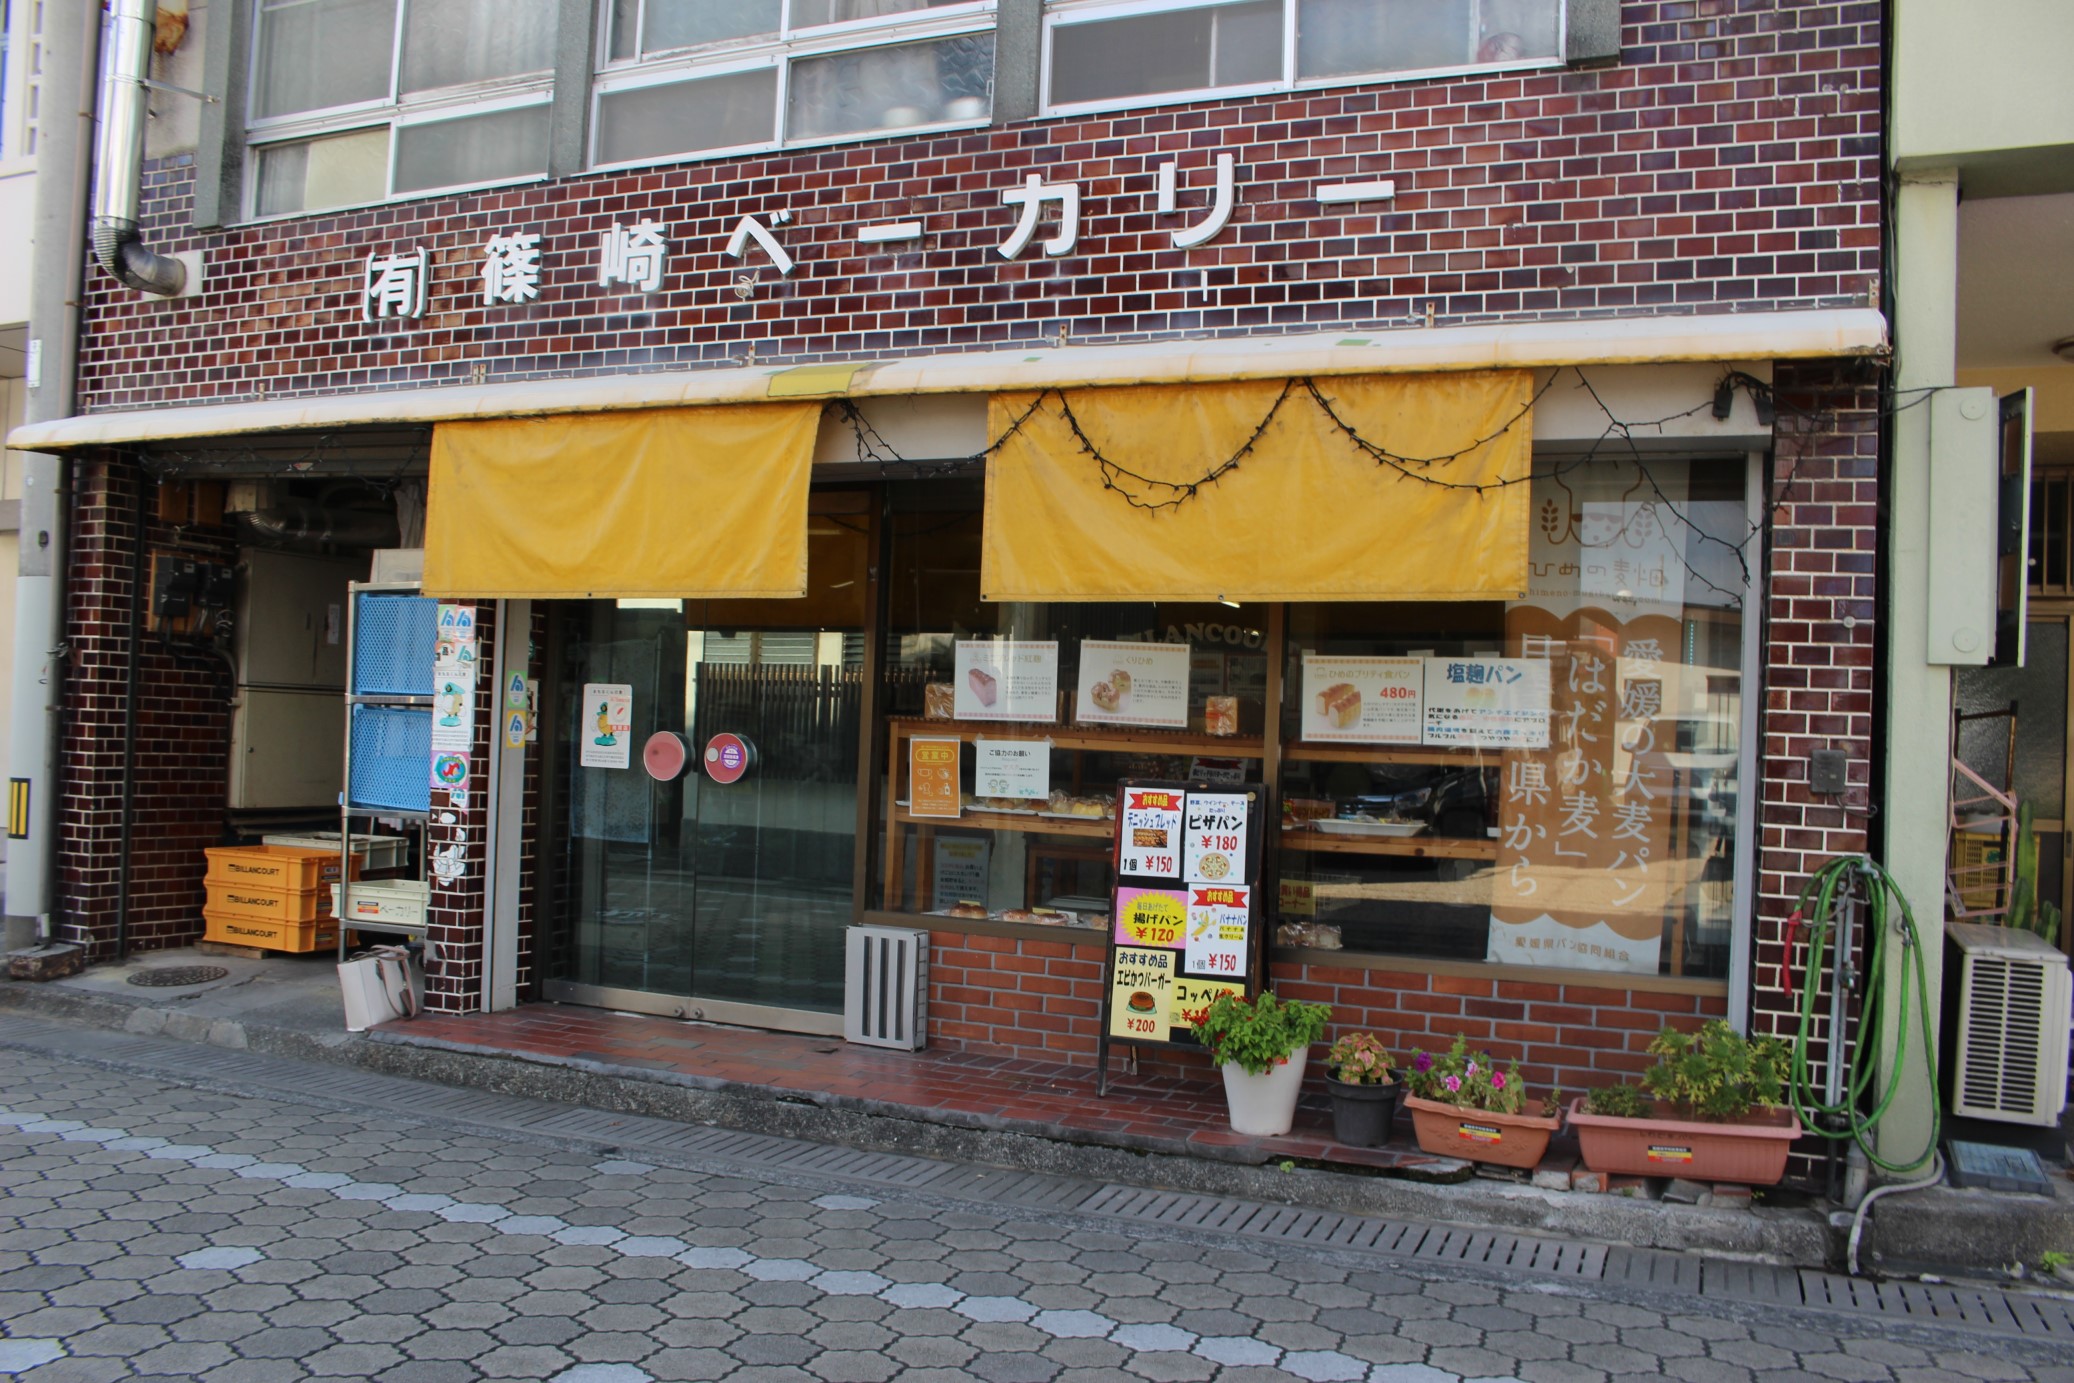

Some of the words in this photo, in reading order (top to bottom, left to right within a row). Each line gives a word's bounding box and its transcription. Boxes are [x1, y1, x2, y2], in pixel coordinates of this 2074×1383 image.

[1447, 662, 1523, 685] 塩麹パン
[1380, 687, 1416, 699] 480円
[921, 751, 949, 760] 営業中
[989, 749, 1031, 758] ご協力のお願い
[1607, 638, 1664, 907] 愛媛の大麦パン
[1142, 794, 1169, 807] おすすめ品
[1189, 815, 1243, 831] ピザパン
[1201, 835, 1238, 851] ¥180
[235, 864, 280, 876] BILLANCOURT
[1123, 858, 1138, 871] 1個
[1145, 855, 1173, 873] ¥150
[233, 895, 280, 908] BILLANCOURT
[1206, 890, 1234, 903] おすすめ品
[1137, 902, 1169, 912] 毎日あげたて
[1133, 913, 1183, 926] 揚げパン
[1220, 914, 1248, 925] バナナパン
[232, 926, 278, 939] BILLANCOURT
[1136, 927, 1174, 942] ¥120
[1118, 952, 1168, 969] おすすめ品
[1208, 953, 1237, 971] ¥150
[1116, 970, 1171, 990] エビかつバーガー
[1127, 1018, 1156, 1033] ¥200
